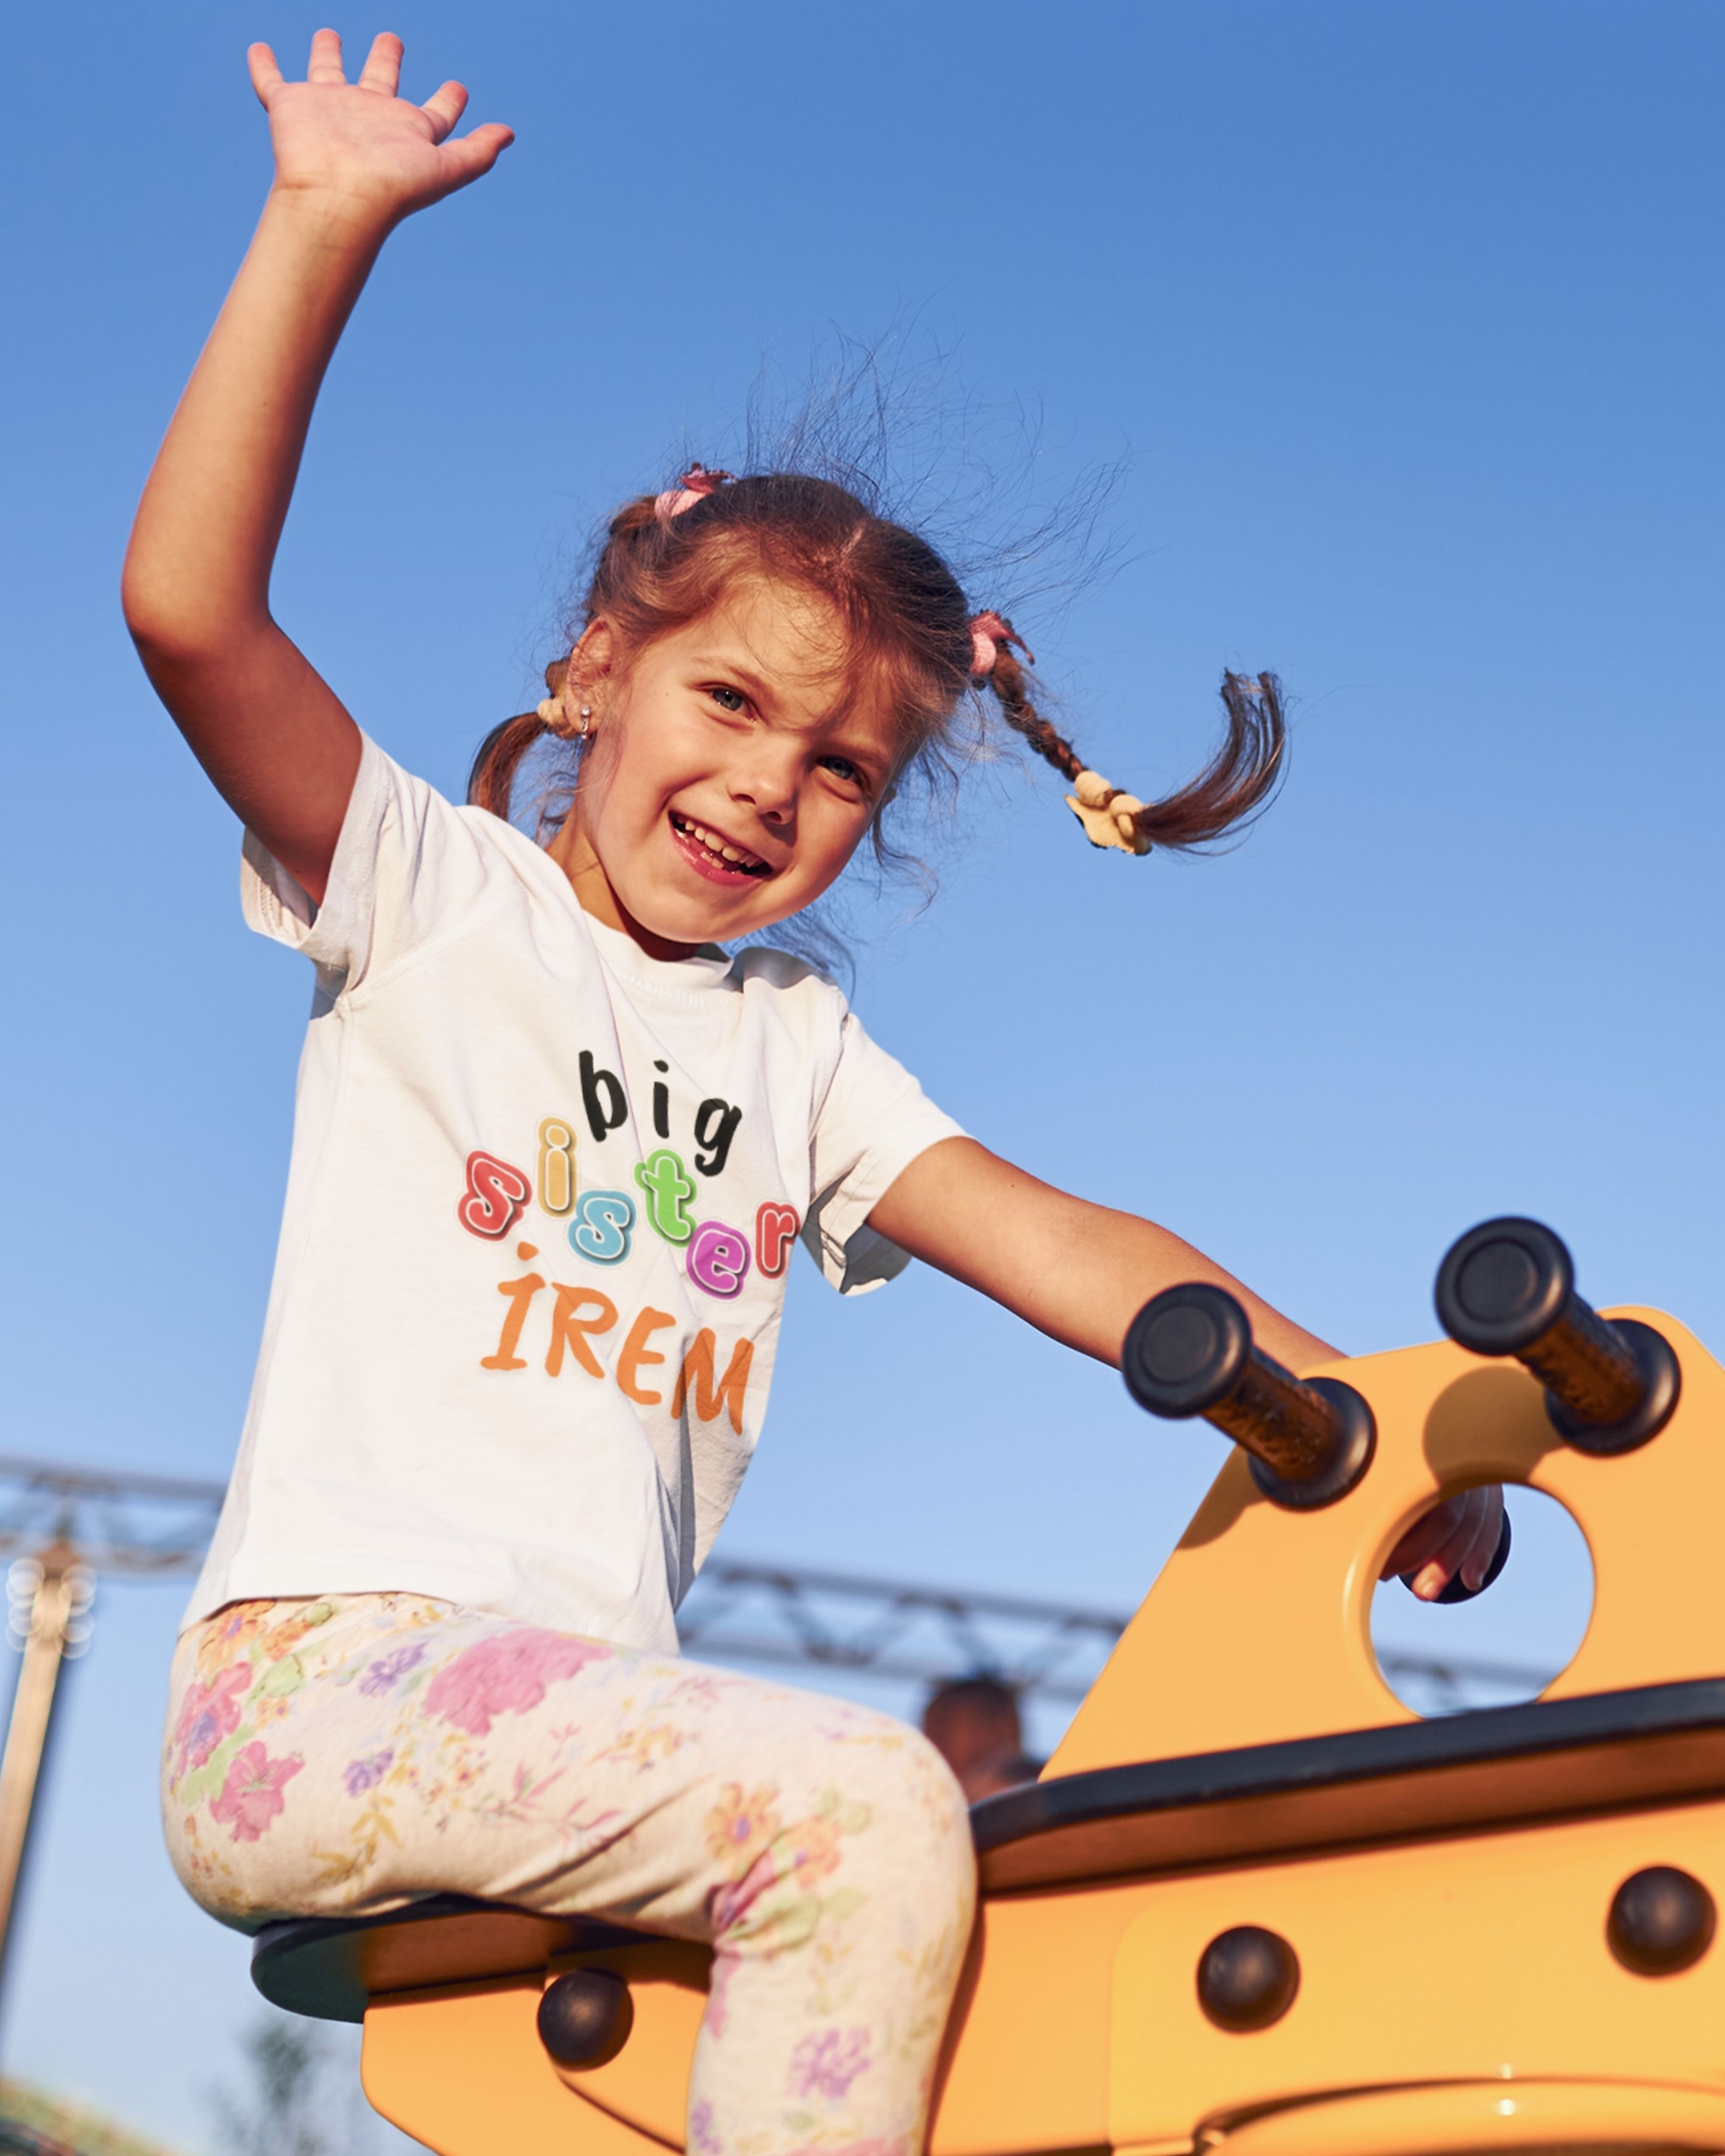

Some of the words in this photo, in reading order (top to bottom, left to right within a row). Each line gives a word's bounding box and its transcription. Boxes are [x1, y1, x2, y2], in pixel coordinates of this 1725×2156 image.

[579, 1050, 742, 1177] big
[458, 1117, 800, 1300] sister
[479, 1241, 754, 1436] İREM
